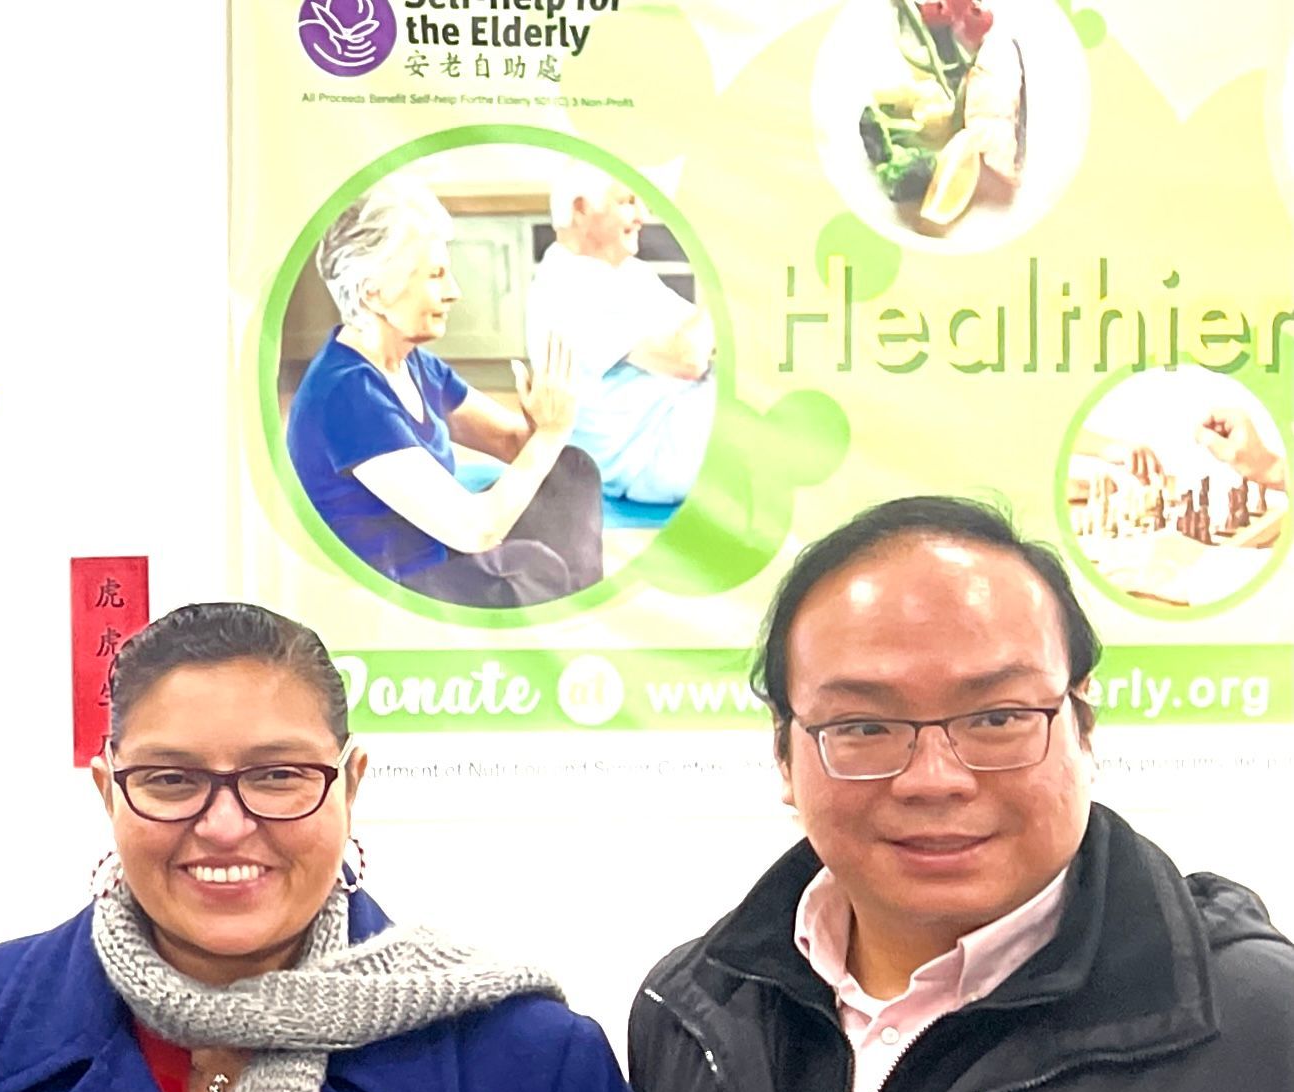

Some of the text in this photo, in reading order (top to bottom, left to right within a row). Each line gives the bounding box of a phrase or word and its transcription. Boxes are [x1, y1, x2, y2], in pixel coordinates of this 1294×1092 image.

[406, 14, 591, 56] the Elderly
[769, 254, 1294, 373] Healthier
